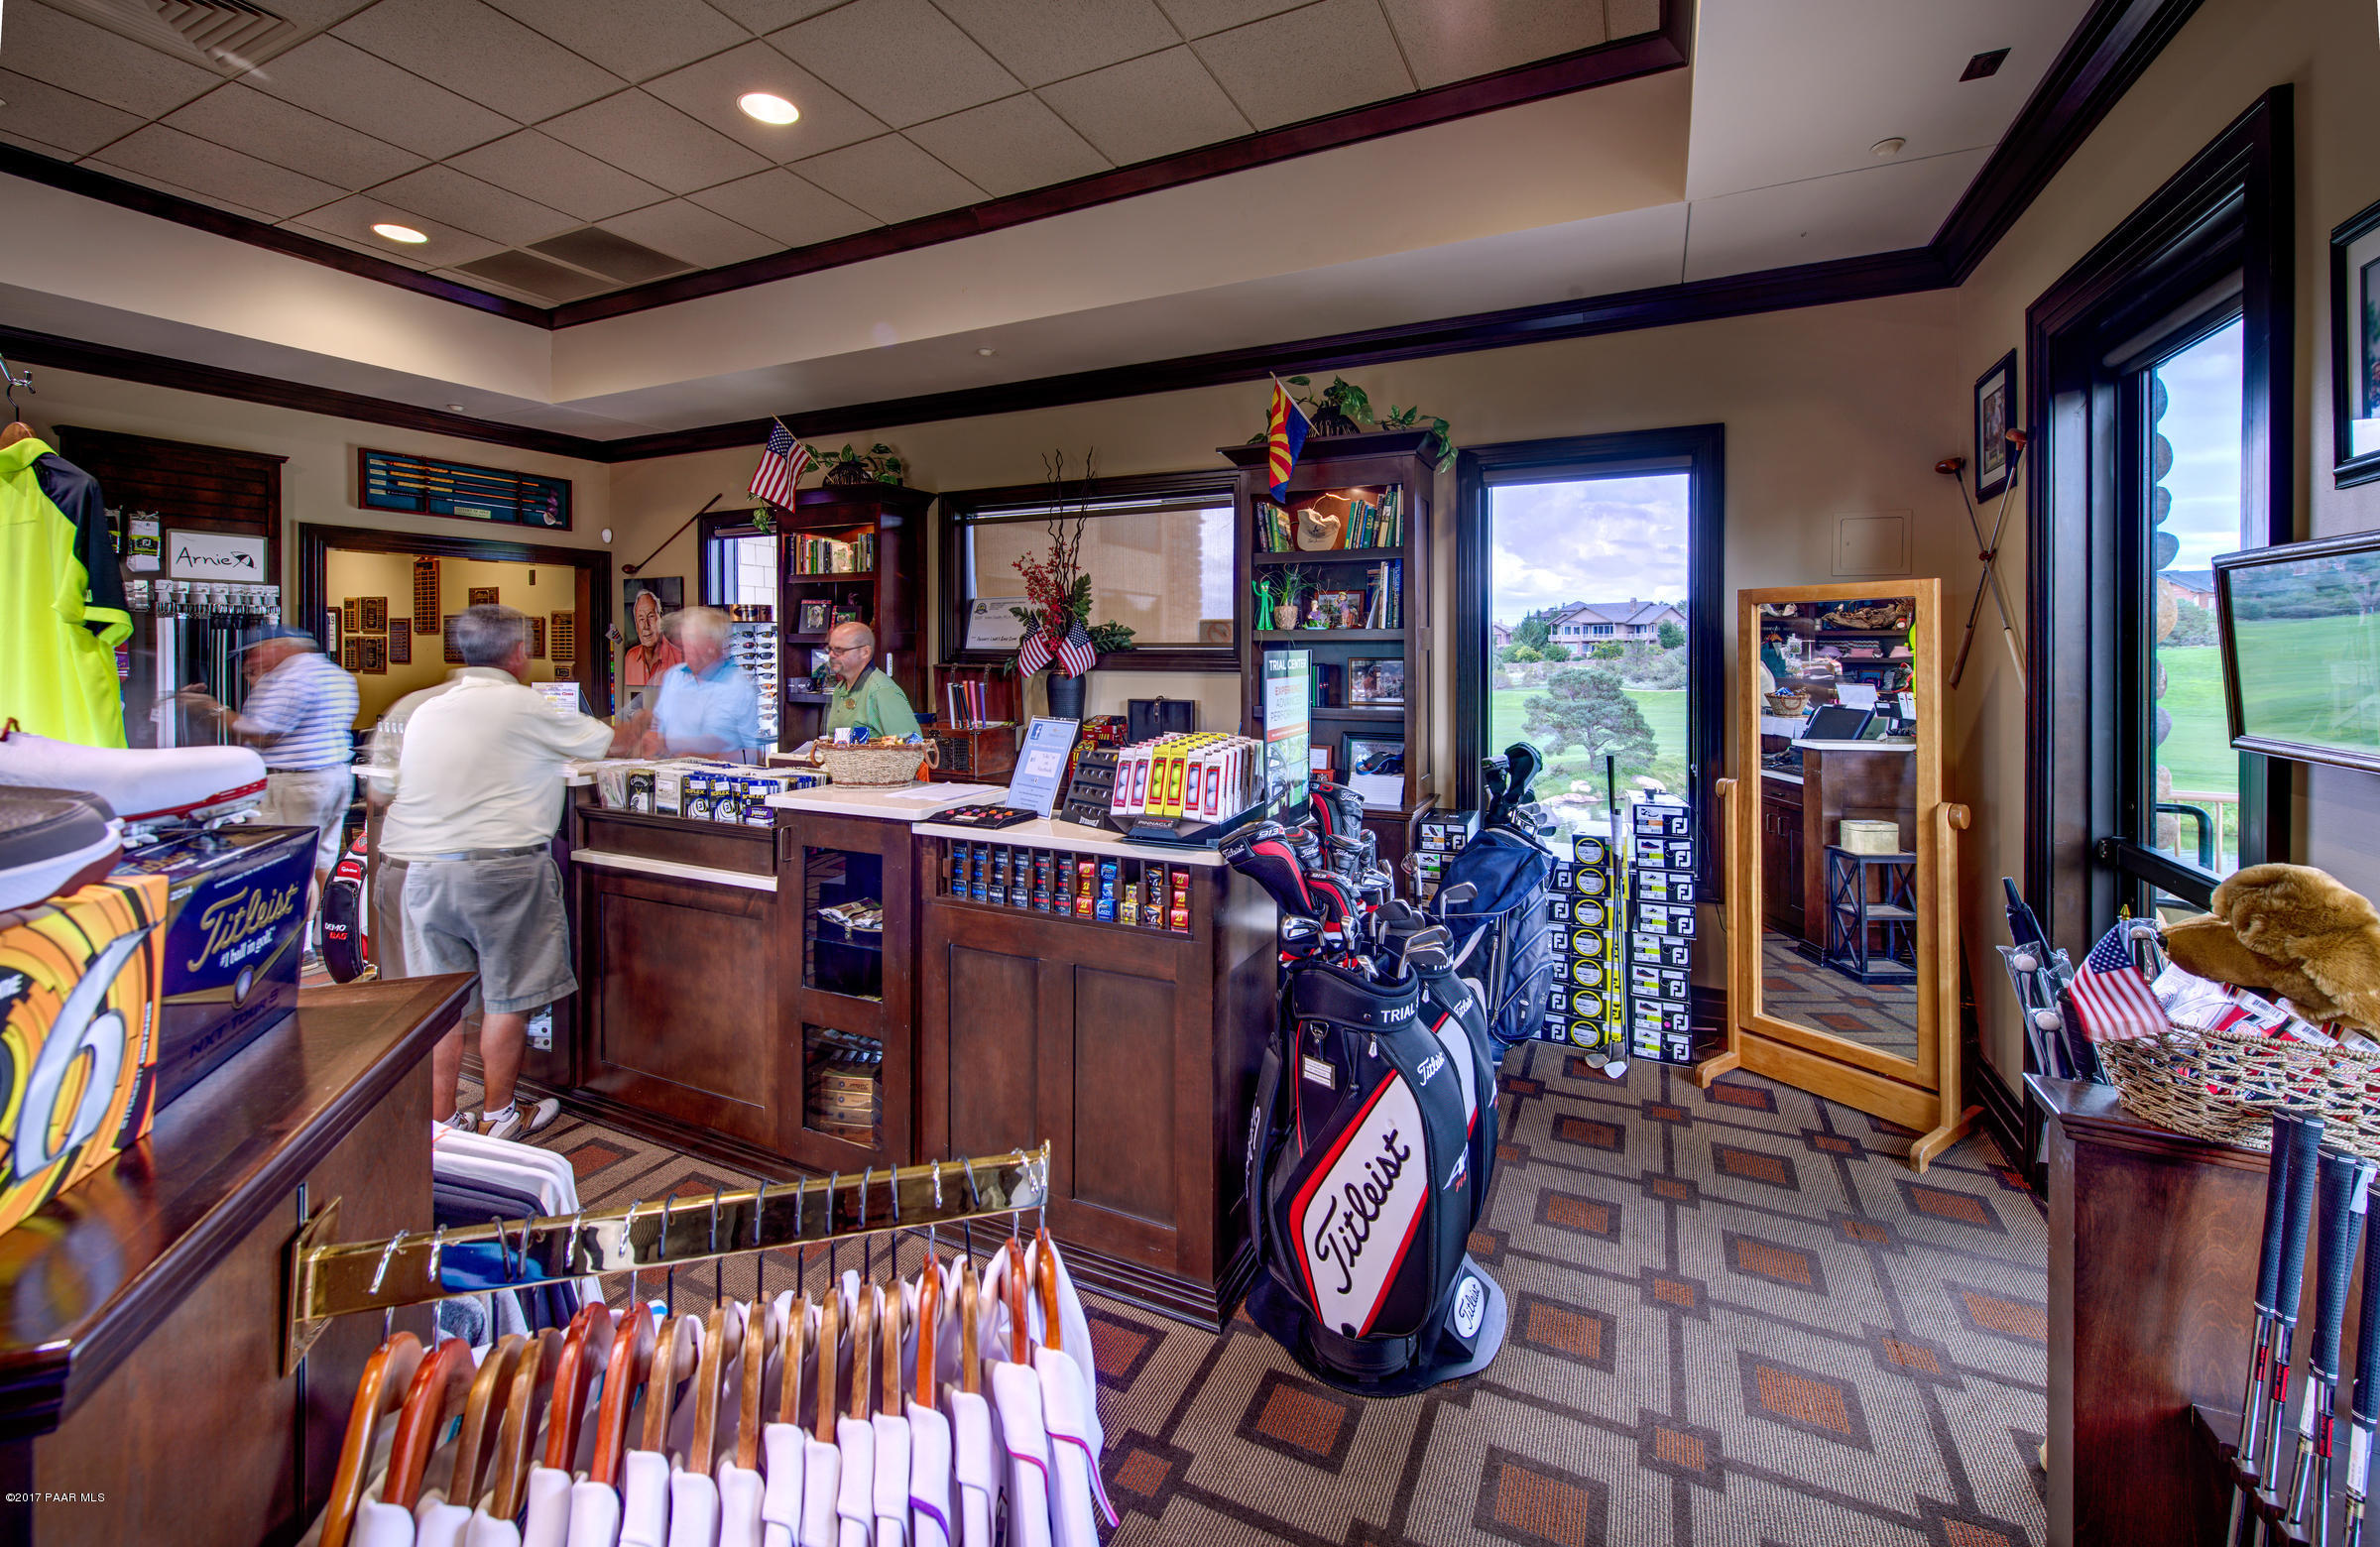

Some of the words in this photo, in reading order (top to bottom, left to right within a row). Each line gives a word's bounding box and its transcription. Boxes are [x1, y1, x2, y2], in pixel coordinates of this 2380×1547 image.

[176, 546, 231, 567] Arnie
[1269, 659, 1286, 671] TRIAL
[1287, 658, 1307, 668] CENTER
[1672, 817, 1688, 834] FJ
[1452, 835, 1466, 850] FJ
[1676, 851, 1692, 868] FJ
[1558, 872, 1572, 888] FJ
[1678, 884, 1693, 900] FJ
[1555, 902, 1569, 918] FJ
[186, 882, 298, 972] Titleist
[324, 922, 347, 931] DEMO
[1678, 916, 1694, 934] FJ
[1553, 932, 1569, 950] FJ
[230, 942, 247, 965] ball
[246, 939, 256, 955] in
[1672, 948, 1688, 964] FJ
[1670, 980, 1686, 998] FJ
[1551, 994, 1567, 1010] FJ
[1380, 1004, 1416, 1023] TRIAL
[1673, 1013, 1689, 1031] FJ
[1551, 1023, 1566, 1041] FJ
[1674, 1043, 1690, 1061] FJ
[1417, 1051, 1446, 1087] Titleist
[1315, 1129, 1410, 1295] Titleist
[1458, 1283, 1481, 1330] Titleist
